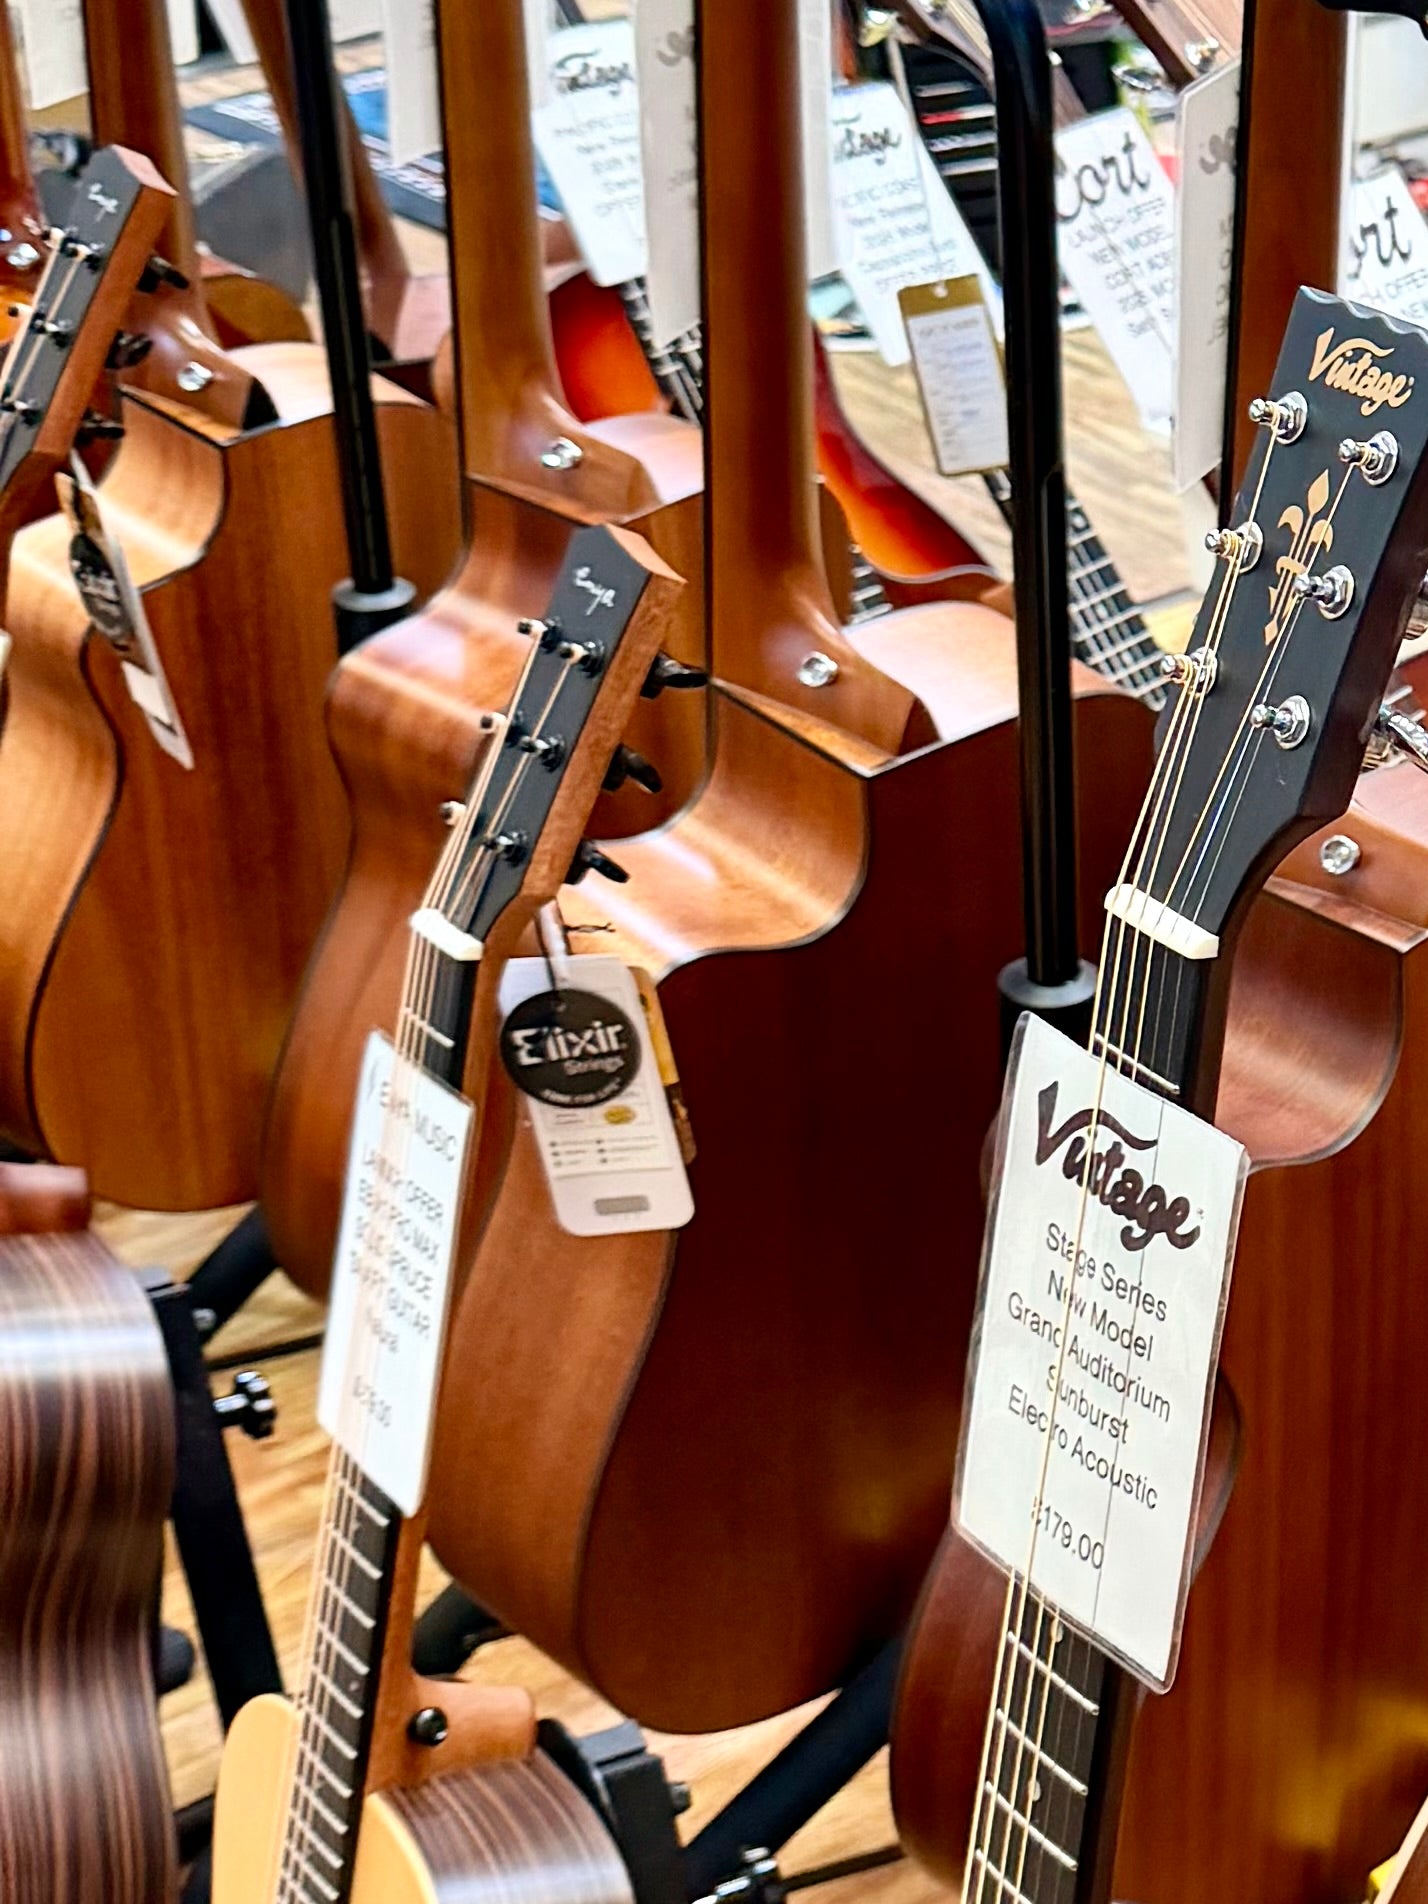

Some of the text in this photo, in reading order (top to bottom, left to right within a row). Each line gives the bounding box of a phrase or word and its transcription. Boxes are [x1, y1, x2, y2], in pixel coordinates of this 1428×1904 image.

[1309, 327, 1414, 416] Vintage
[511, 1020, 627, 1066] Elixir
[1036, 1080, 1205, 1252] Vintage
[1047, 1222, 1168, 1322] Stage Series
[1047, 1268, 1154, 1363] New Model
[1047, 1363, 1130, 1446] Sunburst
[1070, 1341, 1172, 1424] Auditorium
[1072, 1433, 1158, 1512] Acoustic
